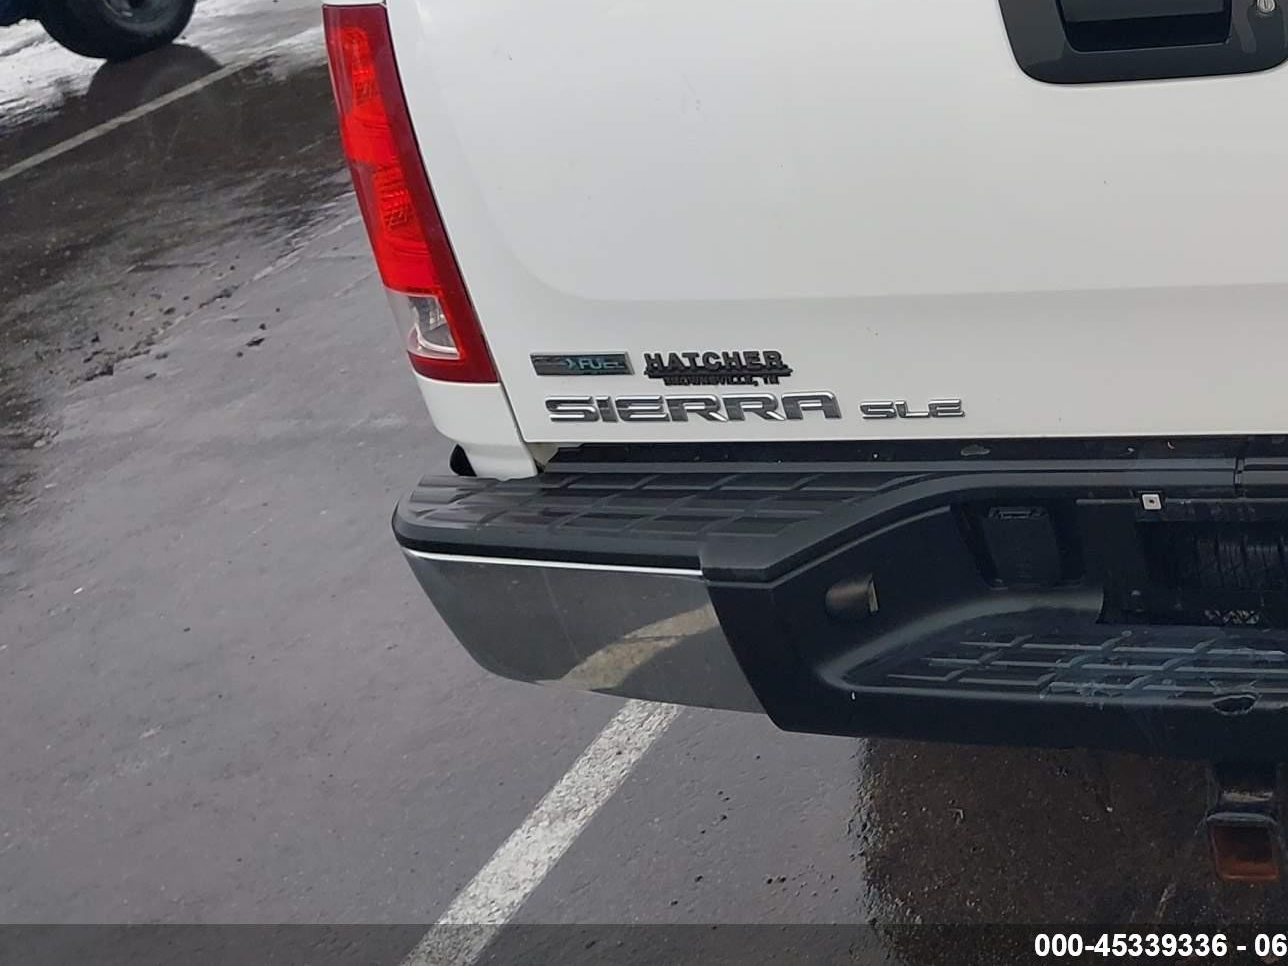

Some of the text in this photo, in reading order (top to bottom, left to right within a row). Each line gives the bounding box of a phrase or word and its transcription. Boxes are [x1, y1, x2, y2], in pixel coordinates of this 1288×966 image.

[644, 351, 784, 371] HATCHER
[545, 390, 965, 423] SIERRA SLE
